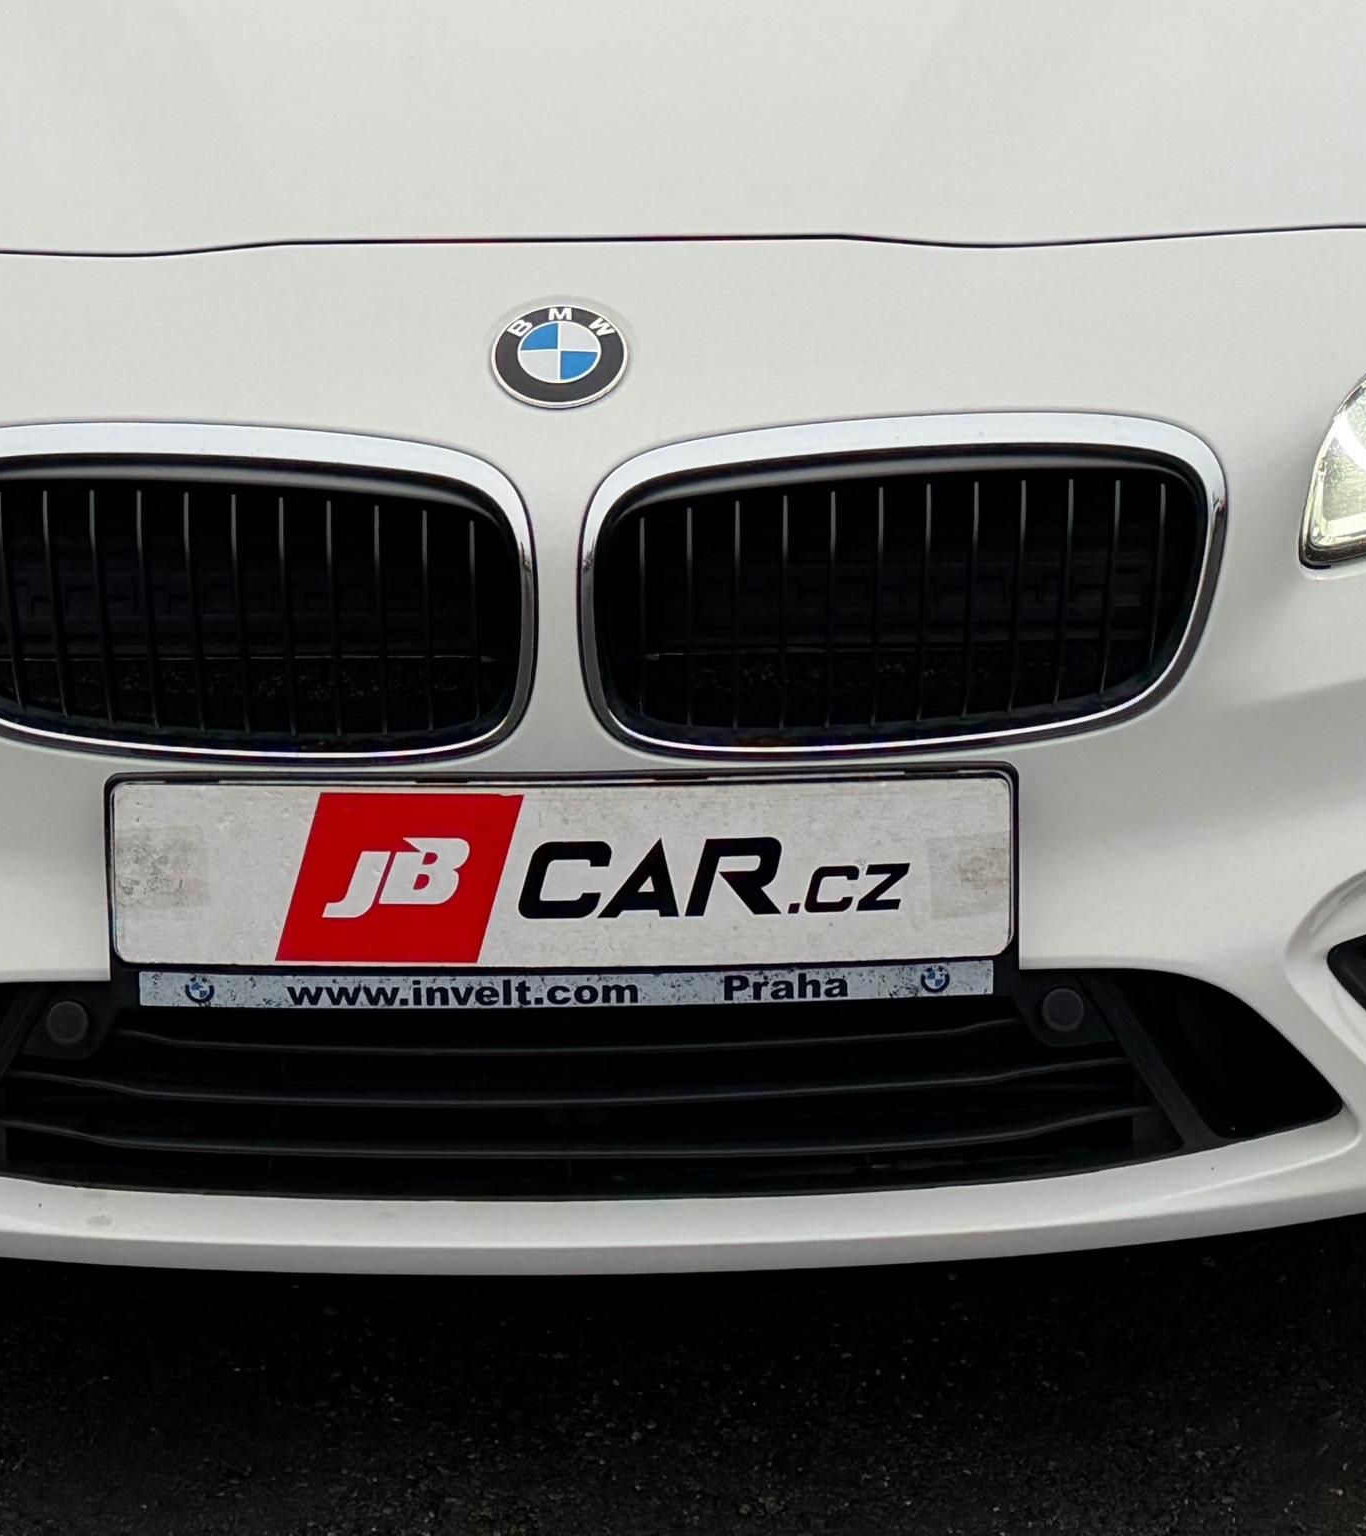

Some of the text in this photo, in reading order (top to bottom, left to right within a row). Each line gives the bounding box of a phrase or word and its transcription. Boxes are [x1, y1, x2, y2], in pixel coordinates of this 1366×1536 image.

[506, 307, 616, 338] BMW
[321, 837, 471, 919] JB
[286, 973, 848, 1006] www.invelt.com Praha
